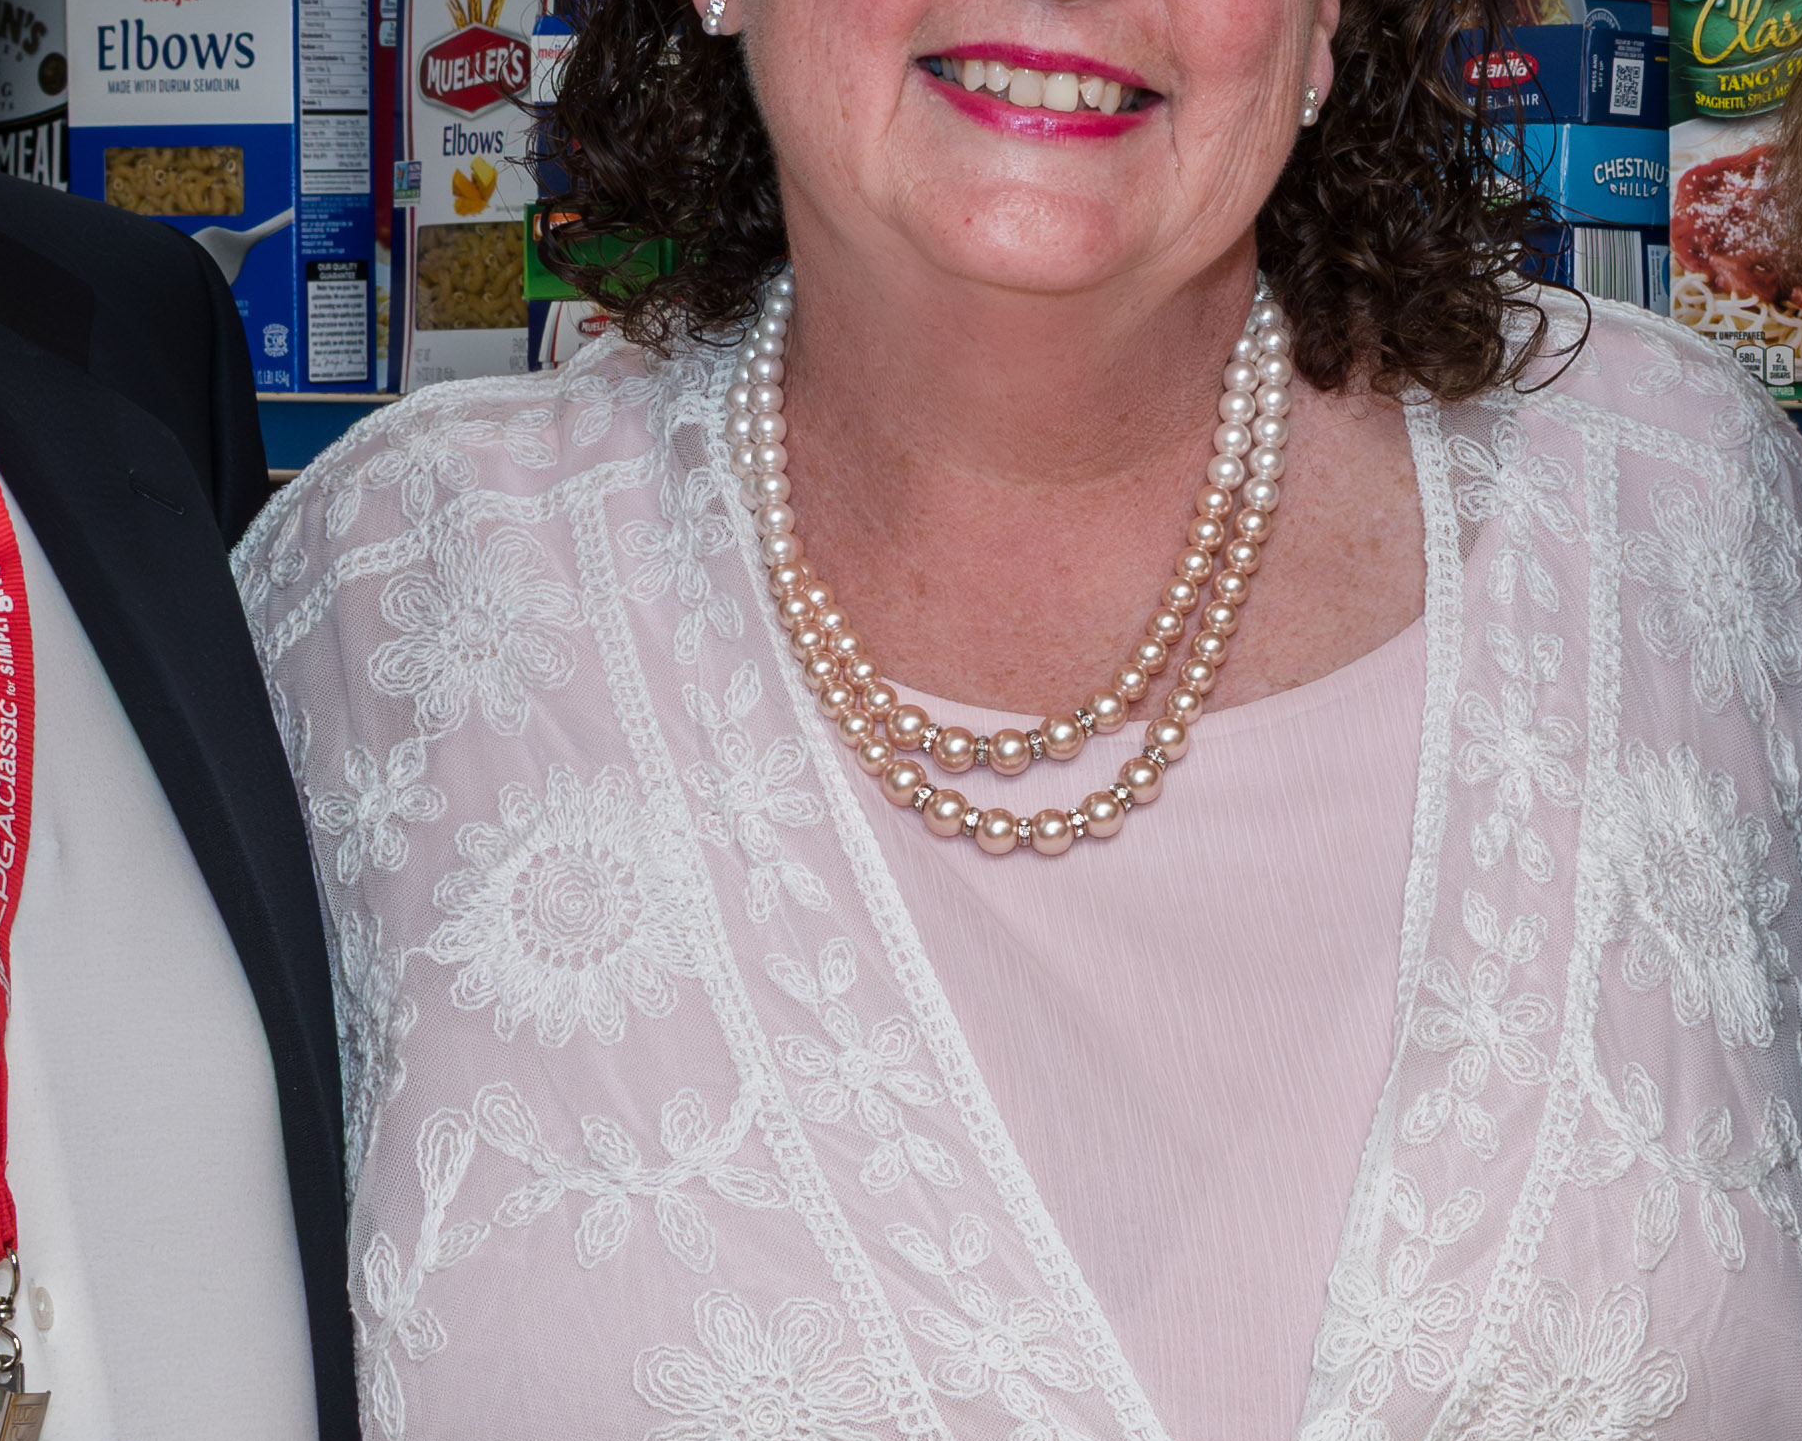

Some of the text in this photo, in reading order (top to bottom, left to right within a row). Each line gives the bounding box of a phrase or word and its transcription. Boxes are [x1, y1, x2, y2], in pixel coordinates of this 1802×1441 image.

[97, 17, 257, 72] Elbows
[107, 77, 241, 95] MADE WITH DURUM SEMOLINA
[442, 122, 505, 158] Elbows
[1619, 182, 1650, 198] HILL
